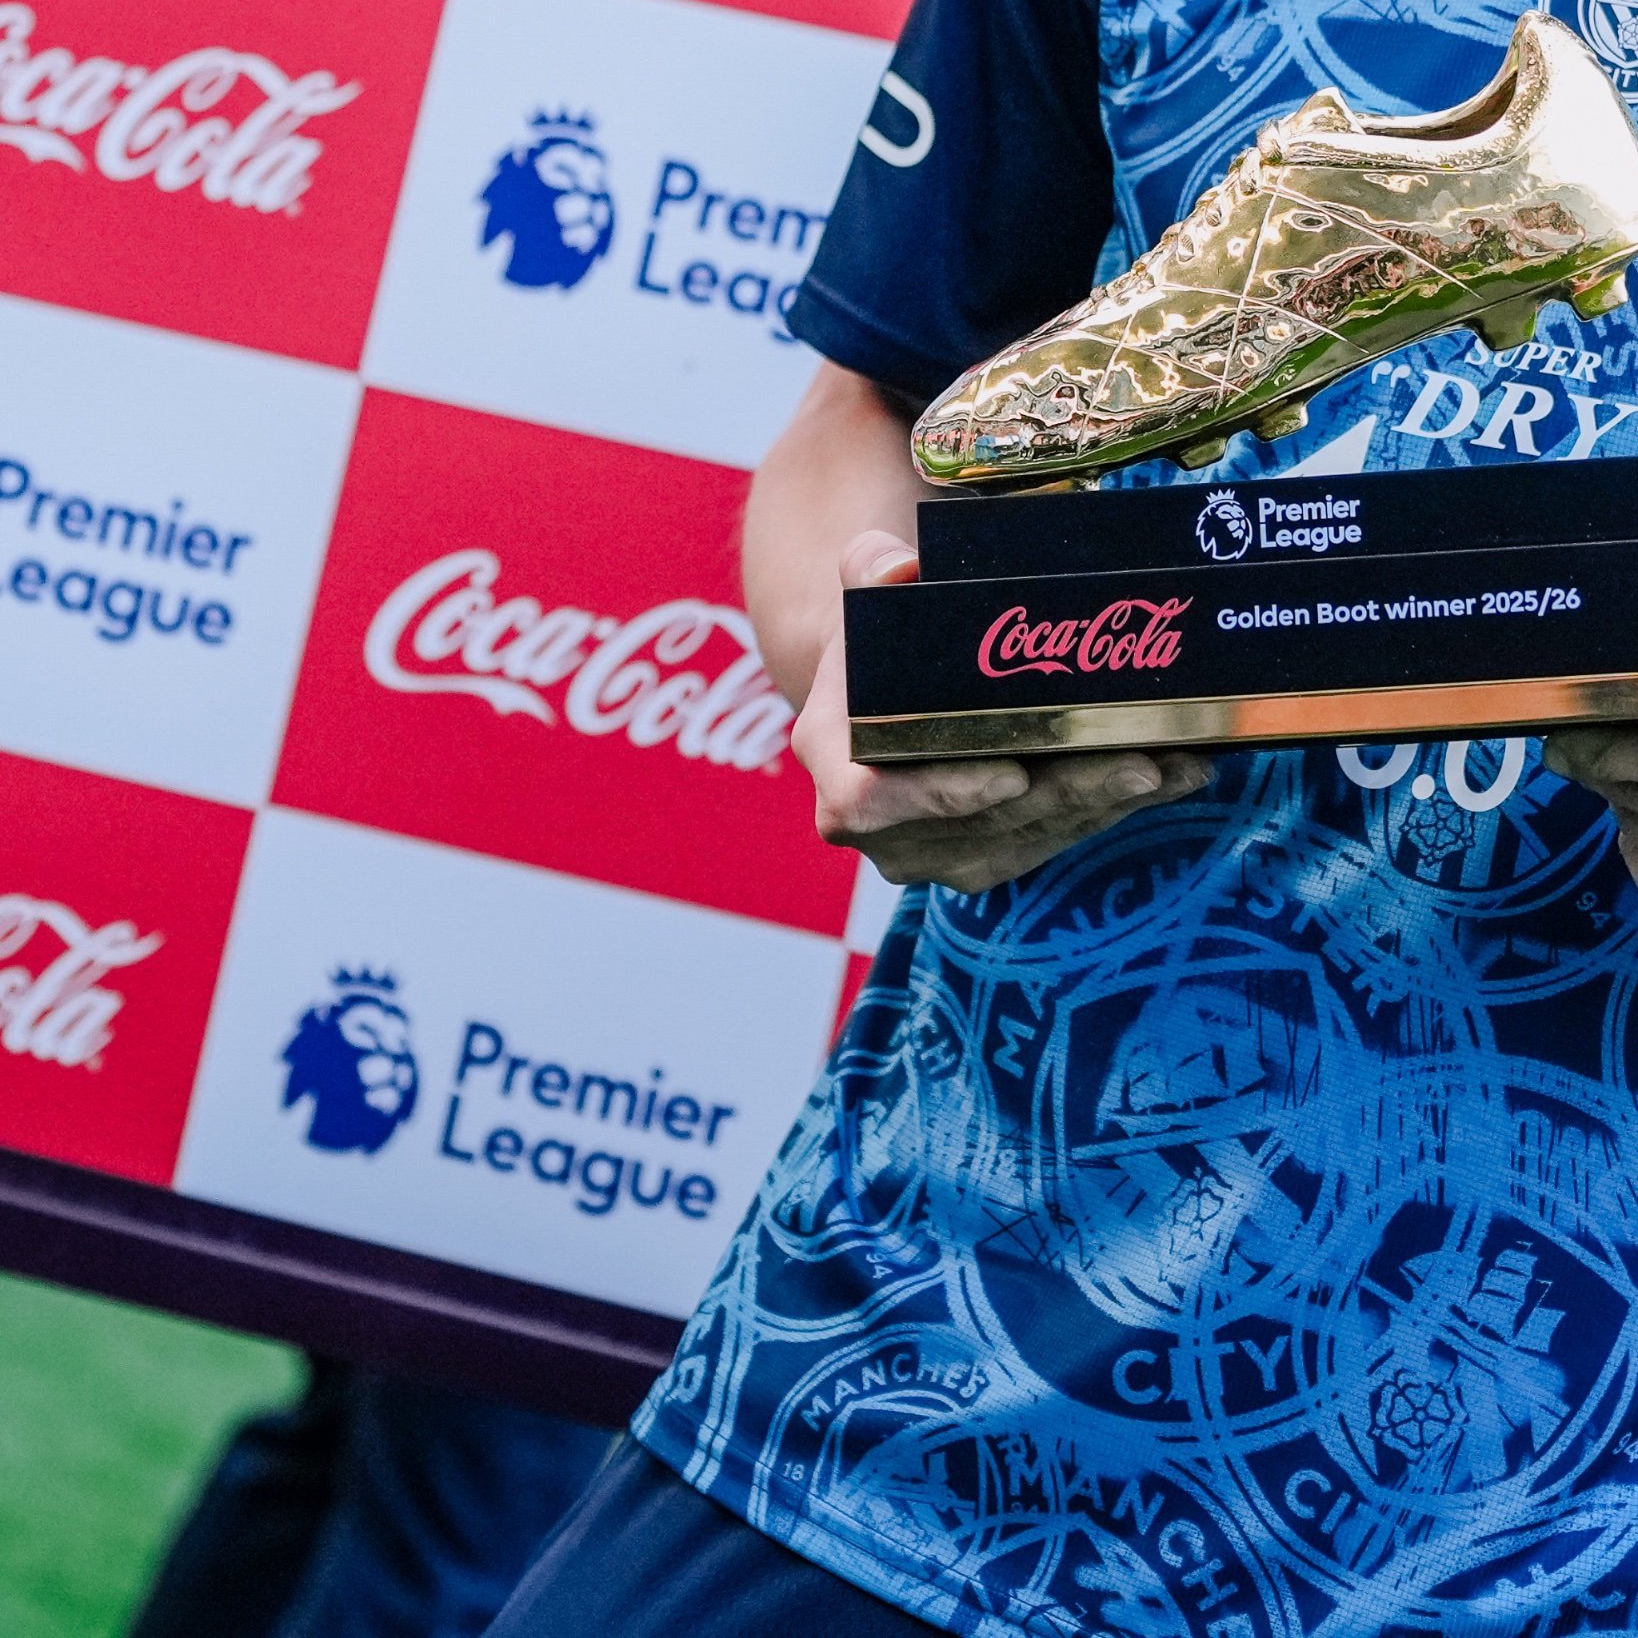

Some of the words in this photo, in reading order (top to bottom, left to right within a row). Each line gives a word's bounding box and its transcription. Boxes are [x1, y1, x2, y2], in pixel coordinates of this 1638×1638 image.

[0, 3, 361, 213] ca-Cola
[652, 160, 828, 251] Prem
[1258, 494, 1361, 524] Premier
[1259, 523, 1363, 553] League
[8, 559, 235, 646] eague
[977, 596, 1194, 677] Coca-Cola
[1217, 604, 1311, 630] Golden
[1317, 599, 1380, 624] Boot
[1384, 595, 1476, 620] winner
[1481, 587, 1582, 617] 2025/26
[456, 1022, 737, 1146] Premier
[439, 1093, 718, 1220] League
[1112, 1334, 1292, 1405] CTY
[783, 1462, 805, 1481] 18
